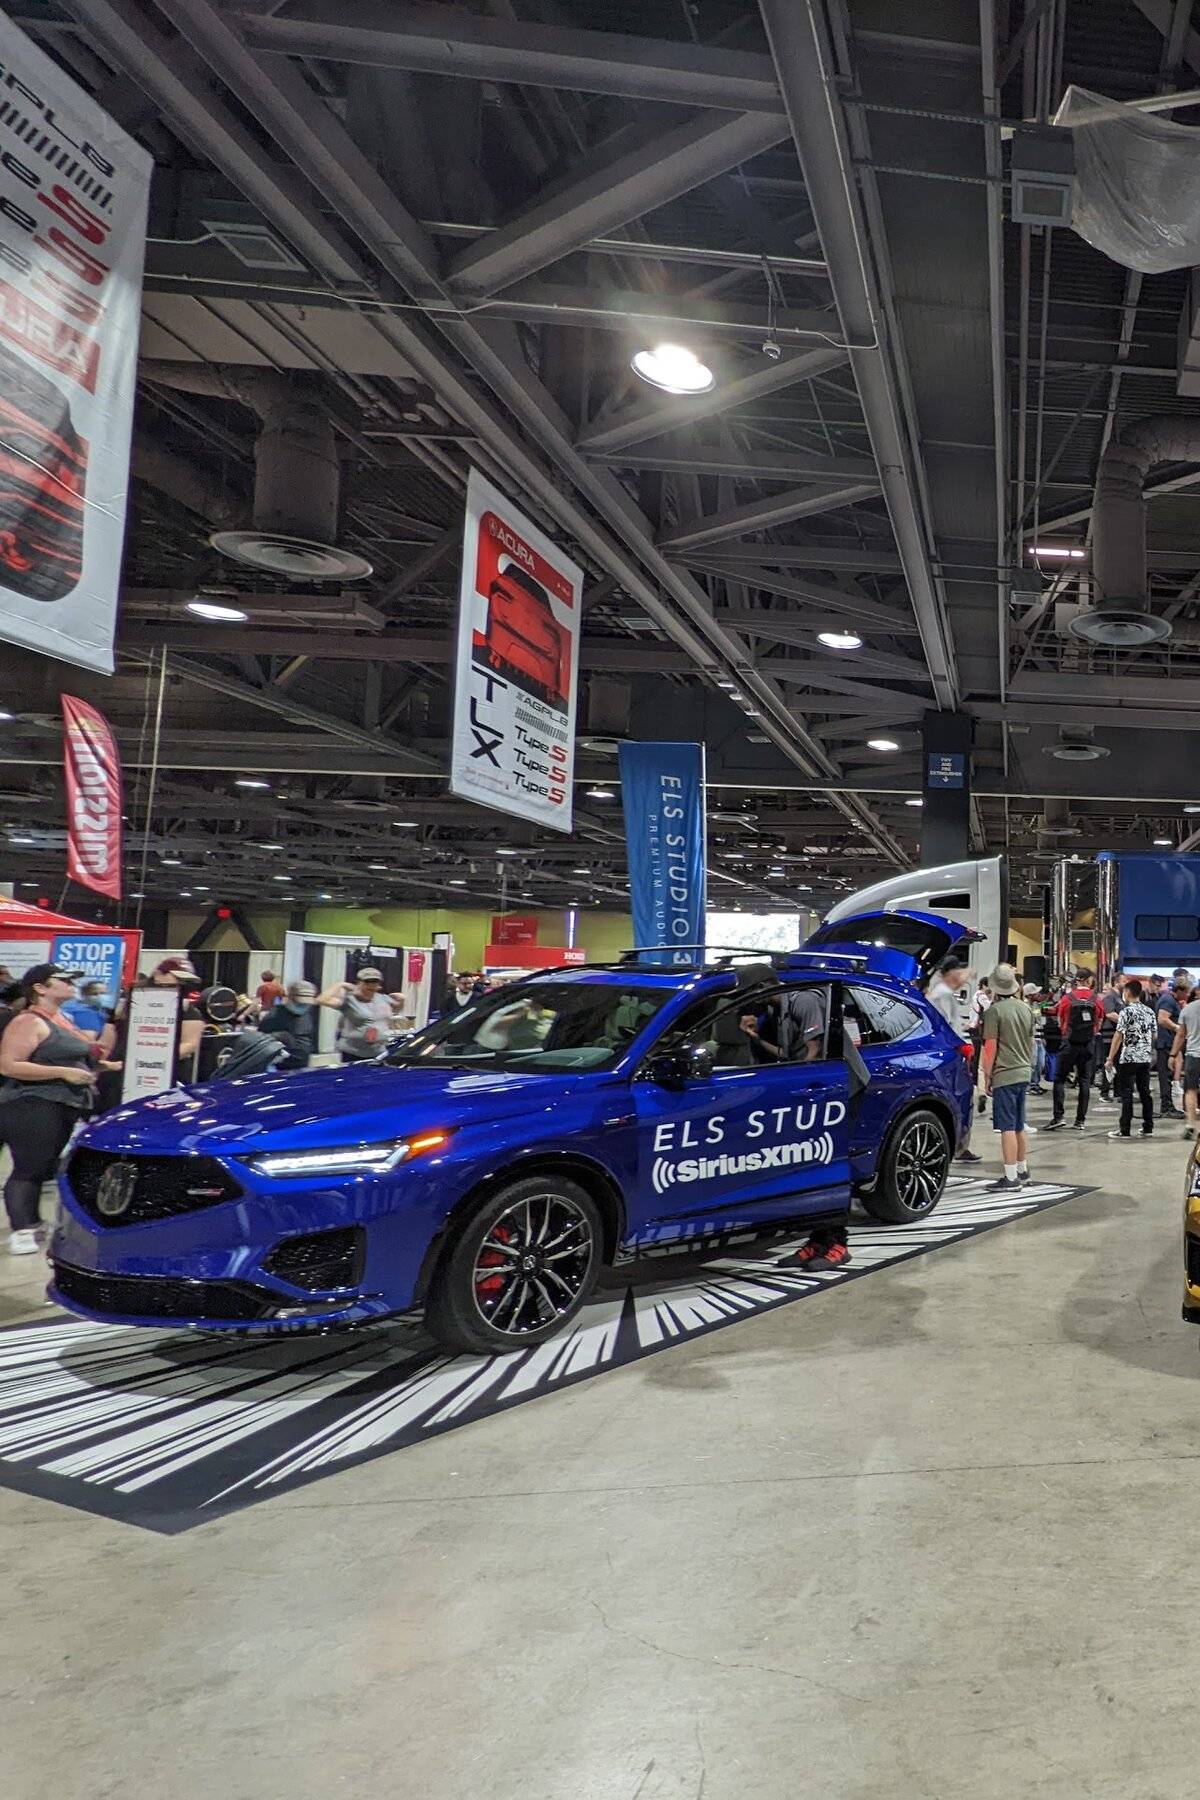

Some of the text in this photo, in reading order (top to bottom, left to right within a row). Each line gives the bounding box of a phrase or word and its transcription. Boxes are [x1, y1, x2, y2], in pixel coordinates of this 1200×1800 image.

[497, 528, 535, 571] ACURA
[661, 775, 684, 820] ELS
[649, 814, 662, 888] PREMIUM
[666, 833, 690, 938] STUDIO
[59, 943, 115, 961] STOP
[653, 1101, 847, 1153] ELS STUD
